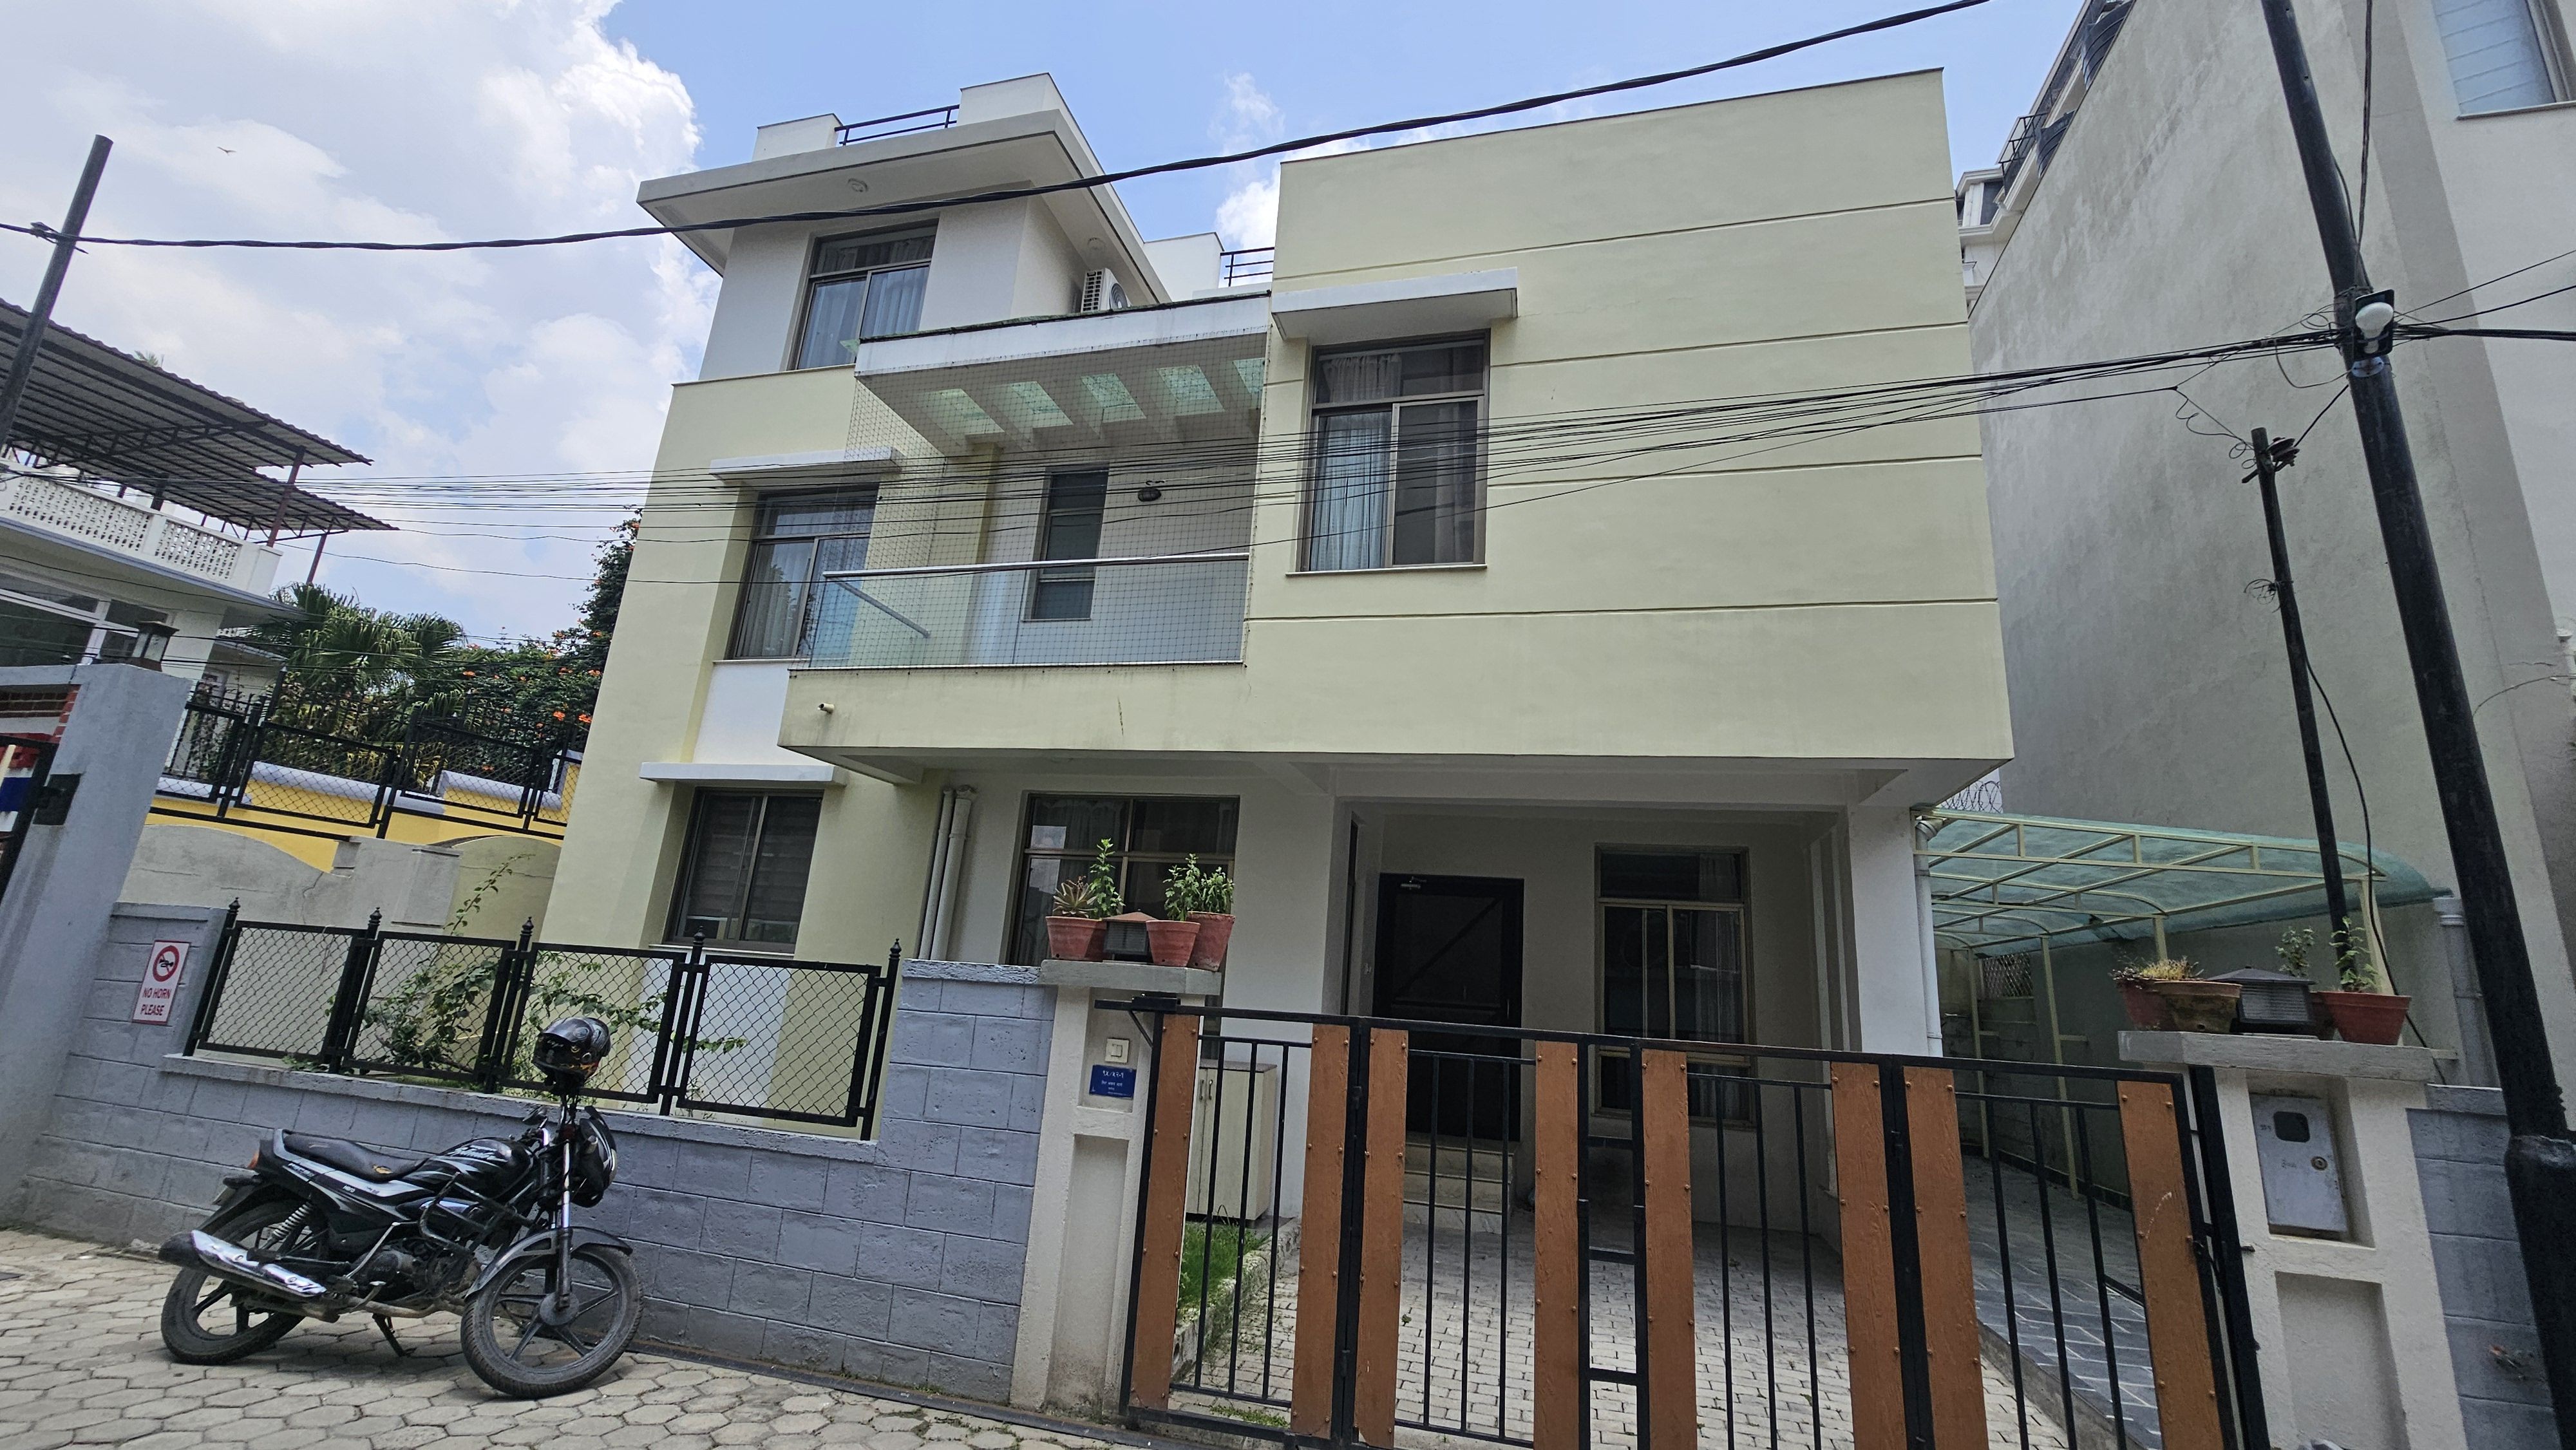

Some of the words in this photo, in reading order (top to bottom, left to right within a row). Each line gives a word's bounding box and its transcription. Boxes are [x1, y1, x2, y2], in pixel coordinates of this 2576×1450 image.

[142, 988, 153, 998] NO
[153, 988, 172, 999] HORN
[140, 1004, 165, 1016] PLEASE
